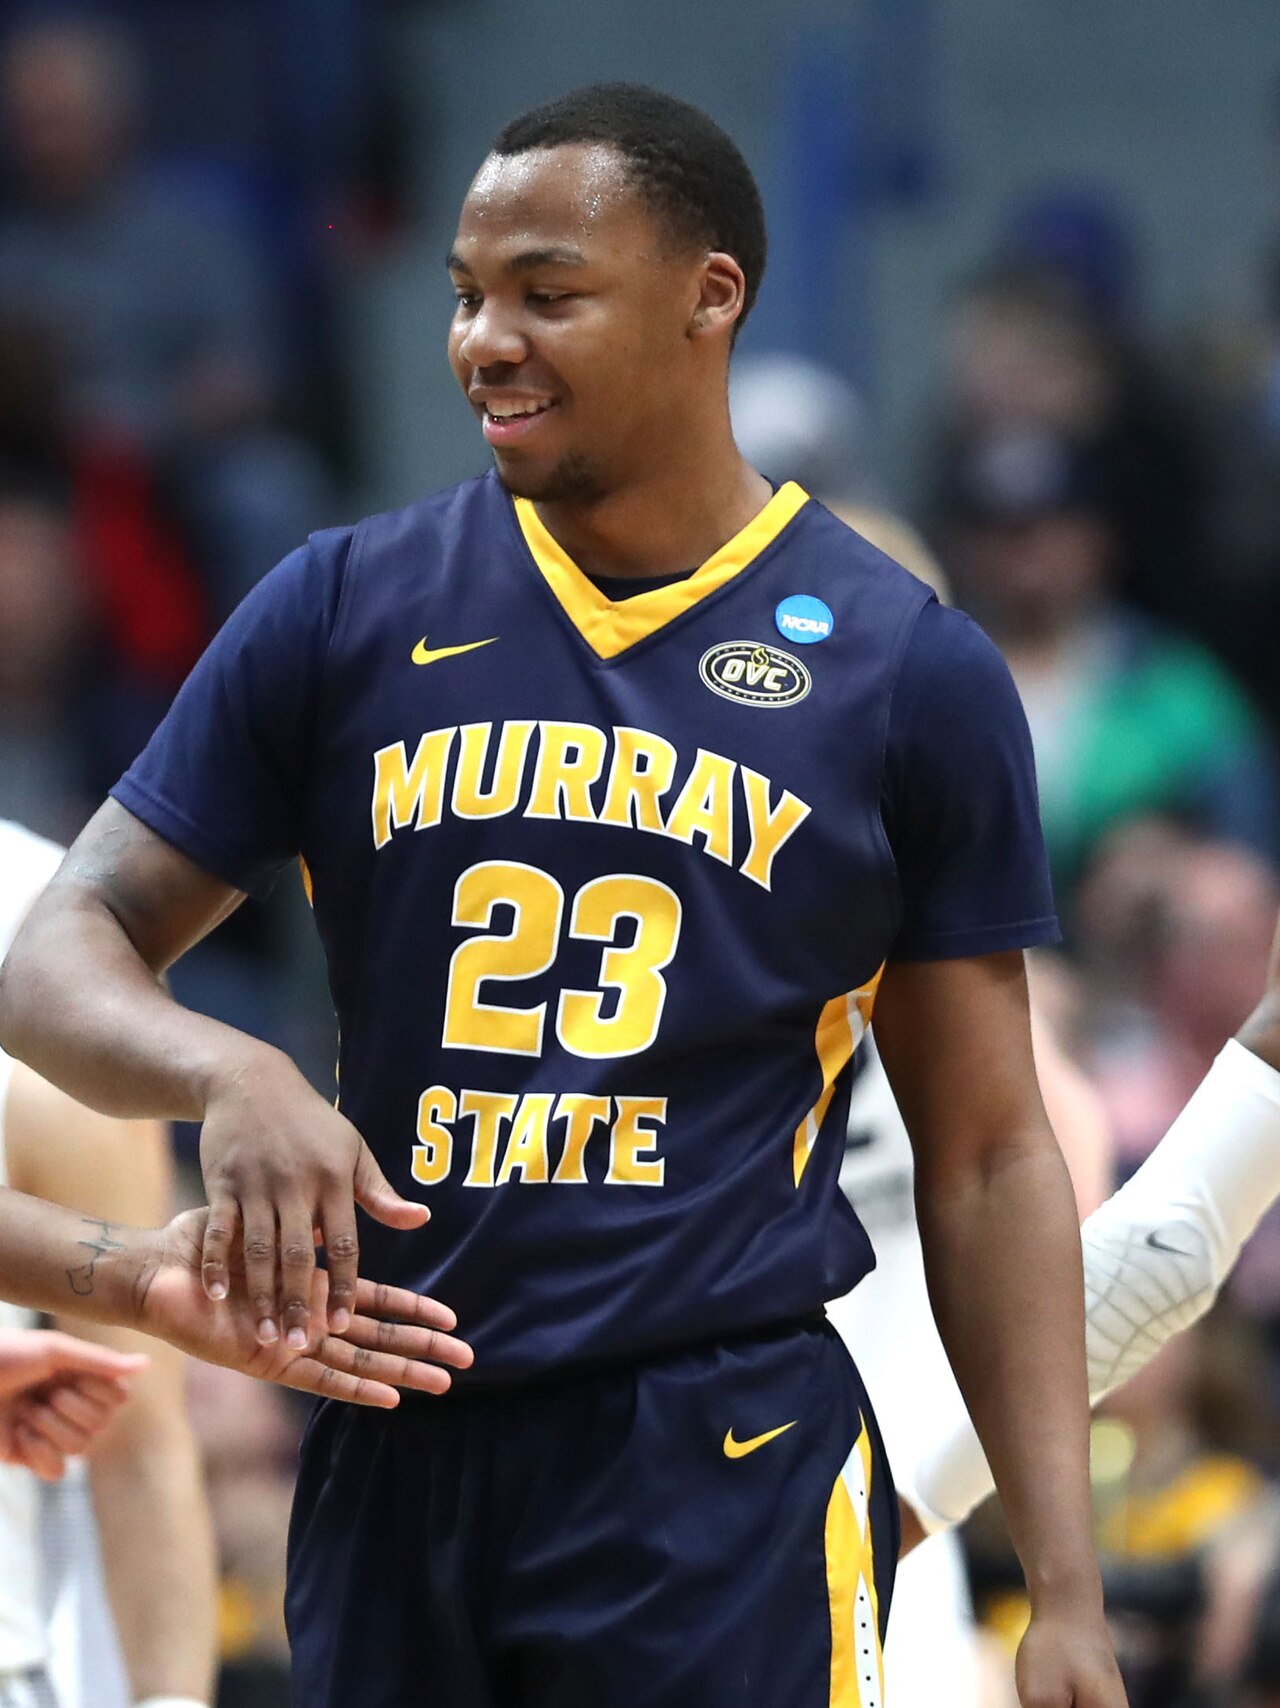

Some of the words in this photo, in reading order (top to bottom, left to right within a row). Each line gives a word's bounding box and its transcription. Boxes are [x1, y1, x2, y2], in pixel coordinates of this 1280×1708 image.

[721, 658, 788, 692] OVC
[781, 614, 829, 635] NCAA
[373, 721, 811, 891] MURRAY
[442, 860, 682, 1059] 23
[411, 1085, 667, 1188] STATE
